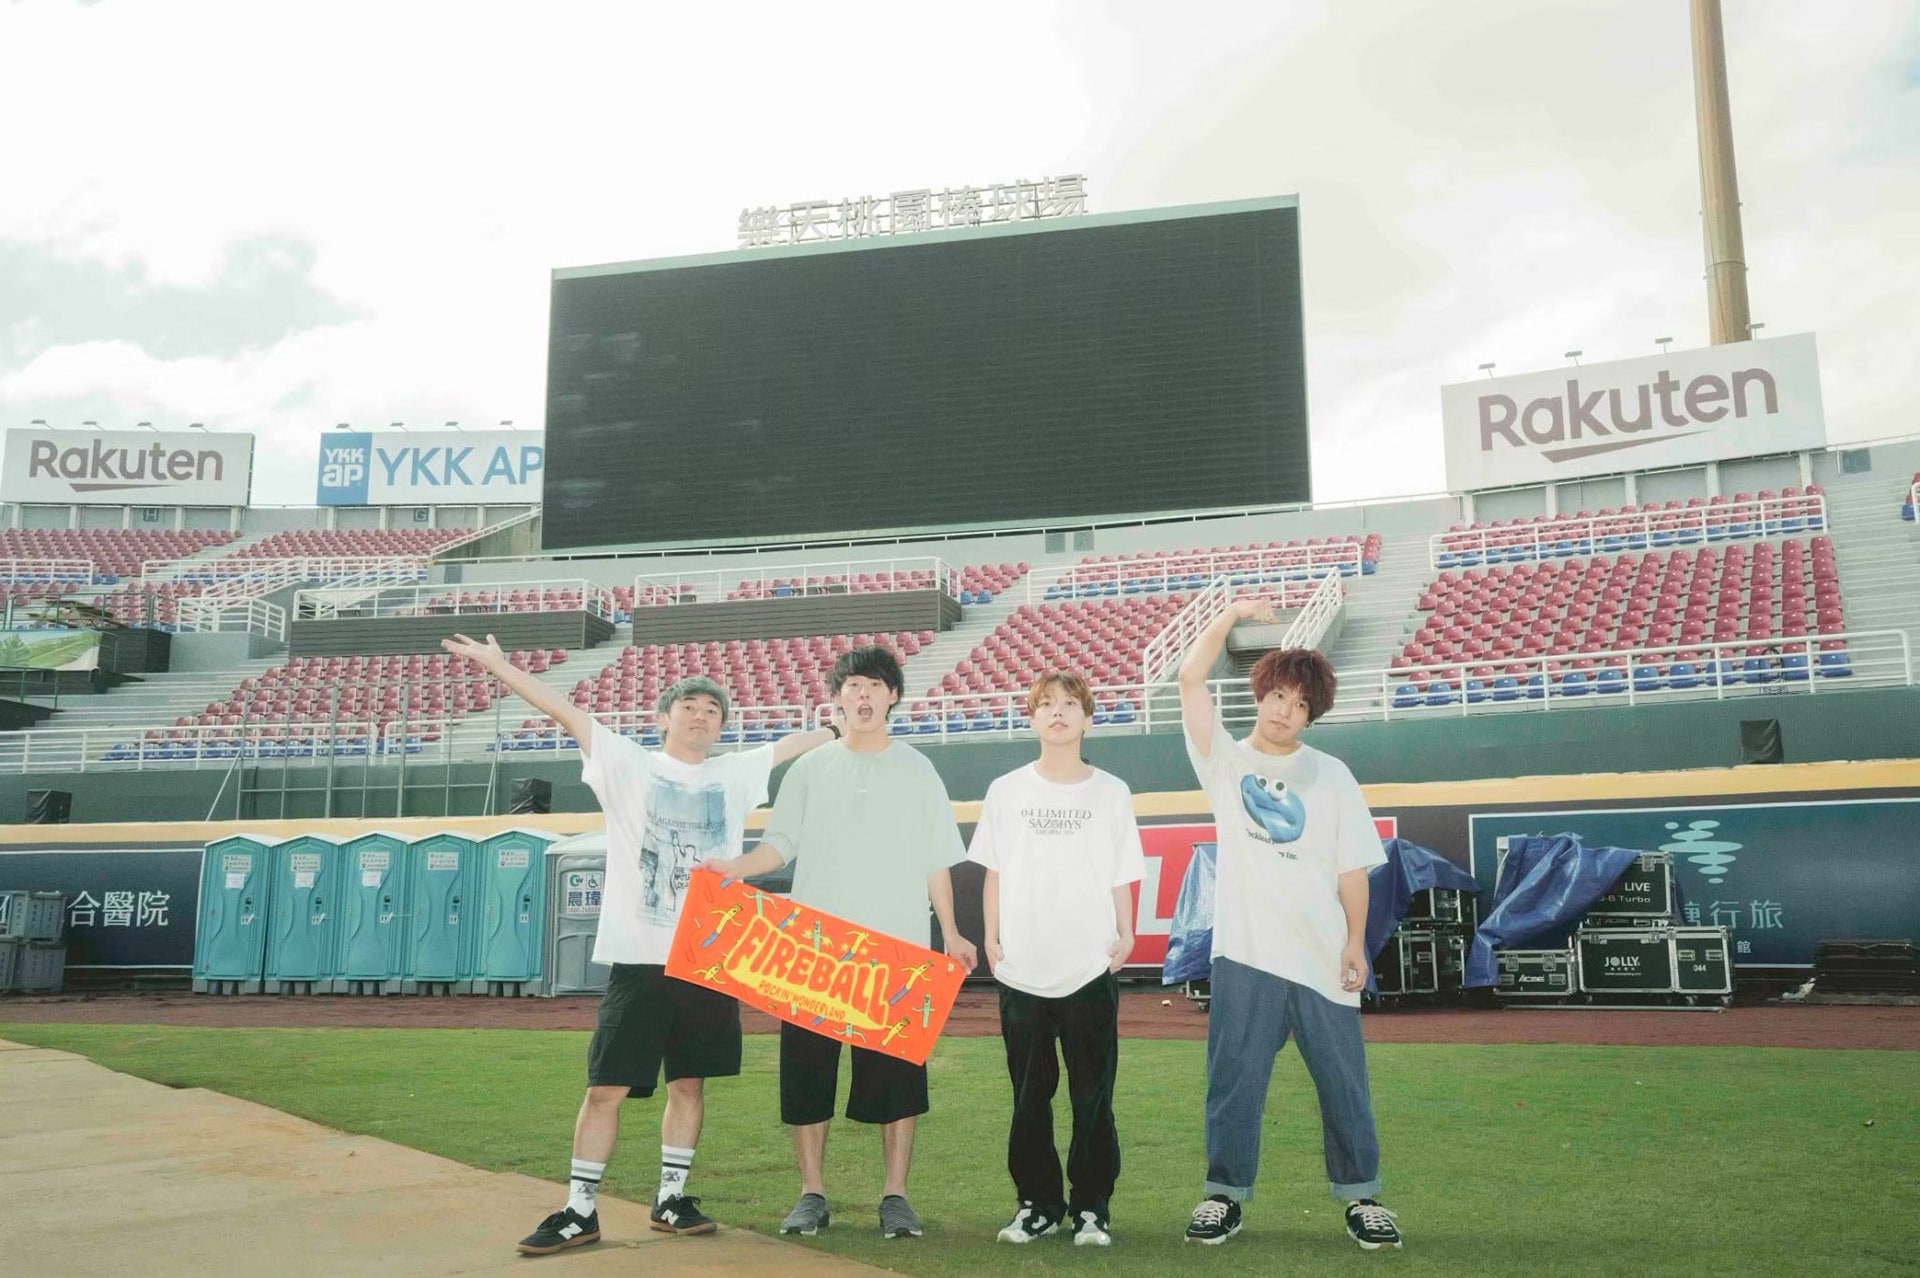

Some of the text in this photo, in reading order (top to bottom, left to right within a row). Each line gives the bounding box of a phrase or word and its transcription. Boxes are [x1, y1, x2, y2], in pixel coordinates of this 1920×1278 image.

[737, 173, 1086, 249] 樂天桃園棒球場
[1477, 366, 1780, 452] Rakuten
[29, 438, 224, 481] Rakuten
[324, 448, 364, 463] YKK
[374, 445, 544, 487] YKK AP
[1038, 808, 1092, 820] LIMITED
[1618, 895, 1651, 903] Turbo
[1624, 882, 1651, 892] LIVE
[67, 890, 171, 927] 合醫院
[726, 917, 888, 1019] FIREBALL
[1604, 956, 1640, 967] JOLLY
[792, 992, 846, 1021] WONDERLAND
